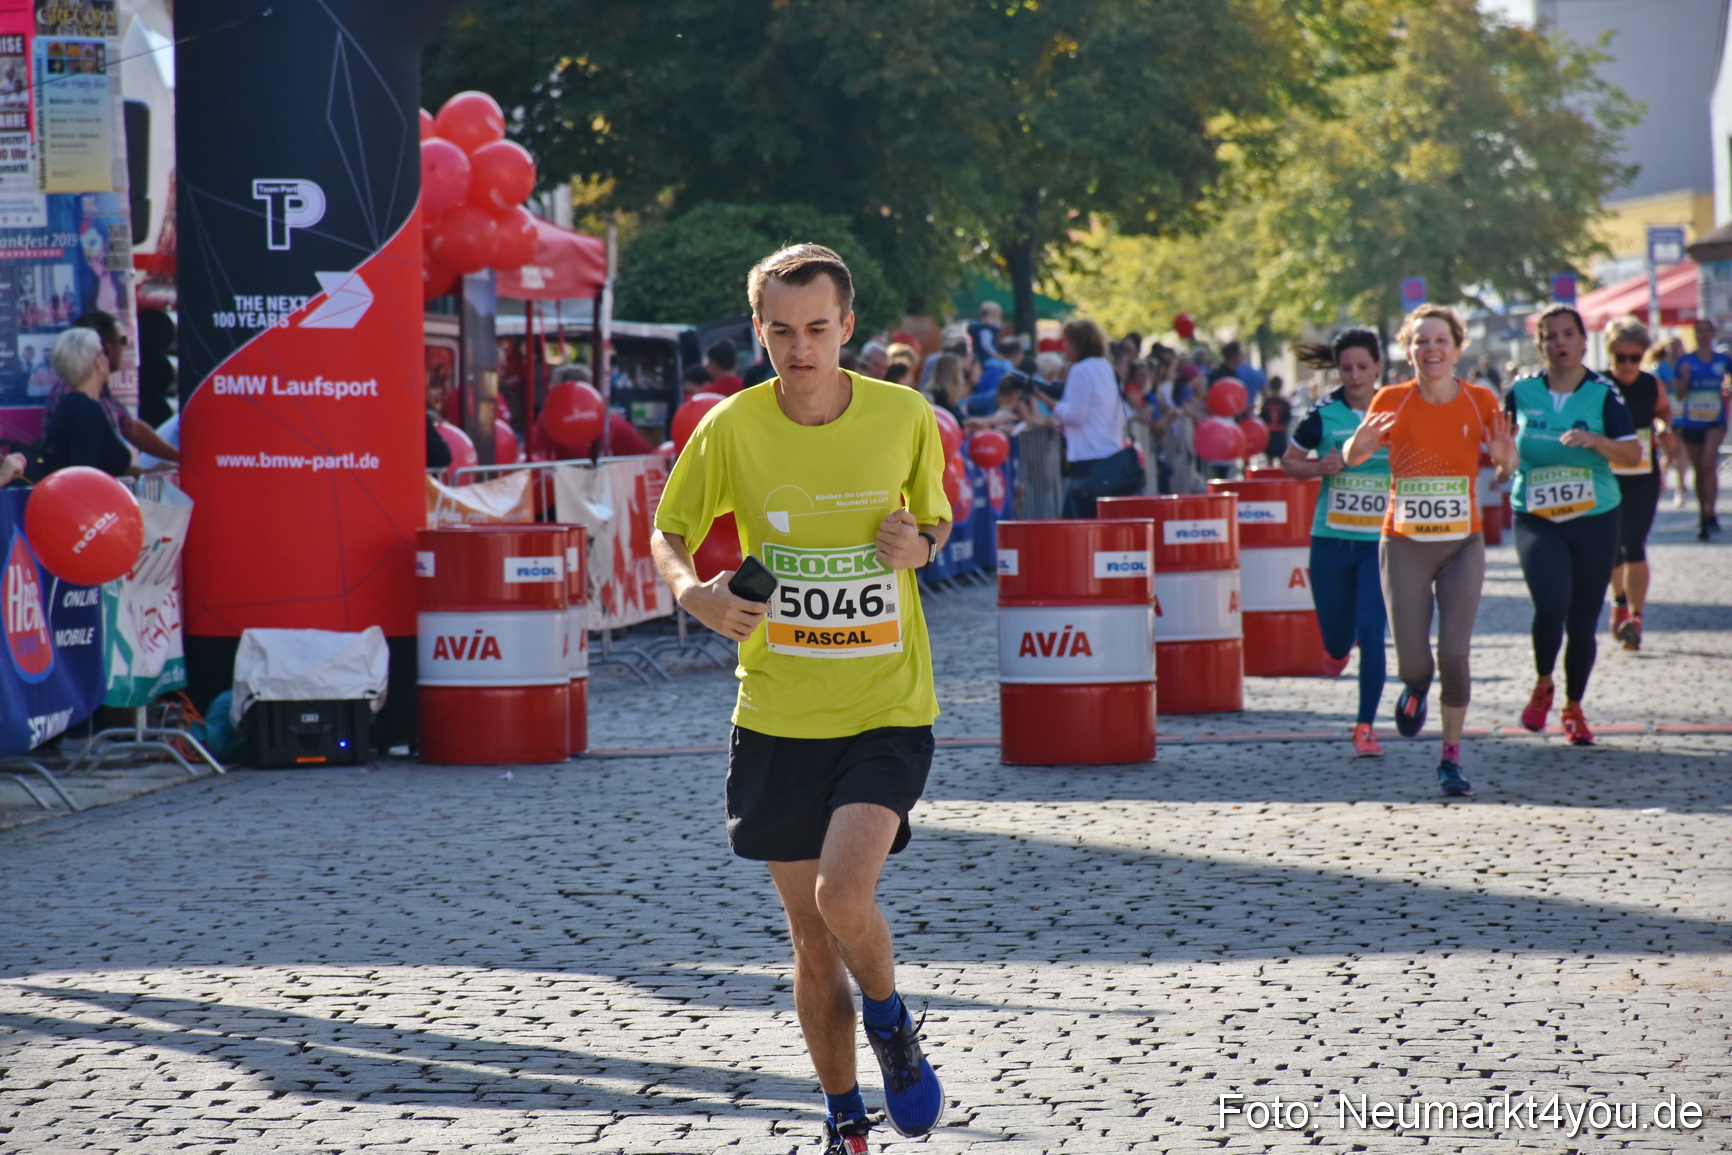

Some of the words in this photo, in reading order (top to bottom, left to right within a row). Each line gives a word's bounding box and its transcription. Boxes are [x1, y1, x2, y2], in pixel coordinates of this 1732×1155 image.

[234, 296, 264, 311] THE
[267, 296, 308, 311] NEXT
[213, 313, 235, 328] 100
[238, 313, 289, 328] YEARS
[213, 376, 266, 395] BMW
[272, 377, 377, 399] Laufsport
[216, 453, 379, 471] www.bmw-partl.de
[1334, 476, 1386, 490] BOCK
[1532, 469, 1587, 485] BOCK
[816, 493, 843, 501] Kliniken
[856, 488, 890, 498] Landkreises
[1402, 480, 1461, 495] BOCK
[1534, 484, 1585, 506] 5167
[836, 498, 868, 507] Neumarkt
[1335, 493, 1386, 513] 5260
[1404, 500, 1461, 519] 5063
[1414, 525, 1451, 534] MARIA
[775, 552, 879, 575] BOCK
[63, 587, 99, 608] ONLINE
[780, 584, 884, 621] 5046
[55, 627, 95, 648] MOBILE
[794, 629, 872, 645] PASCAL
